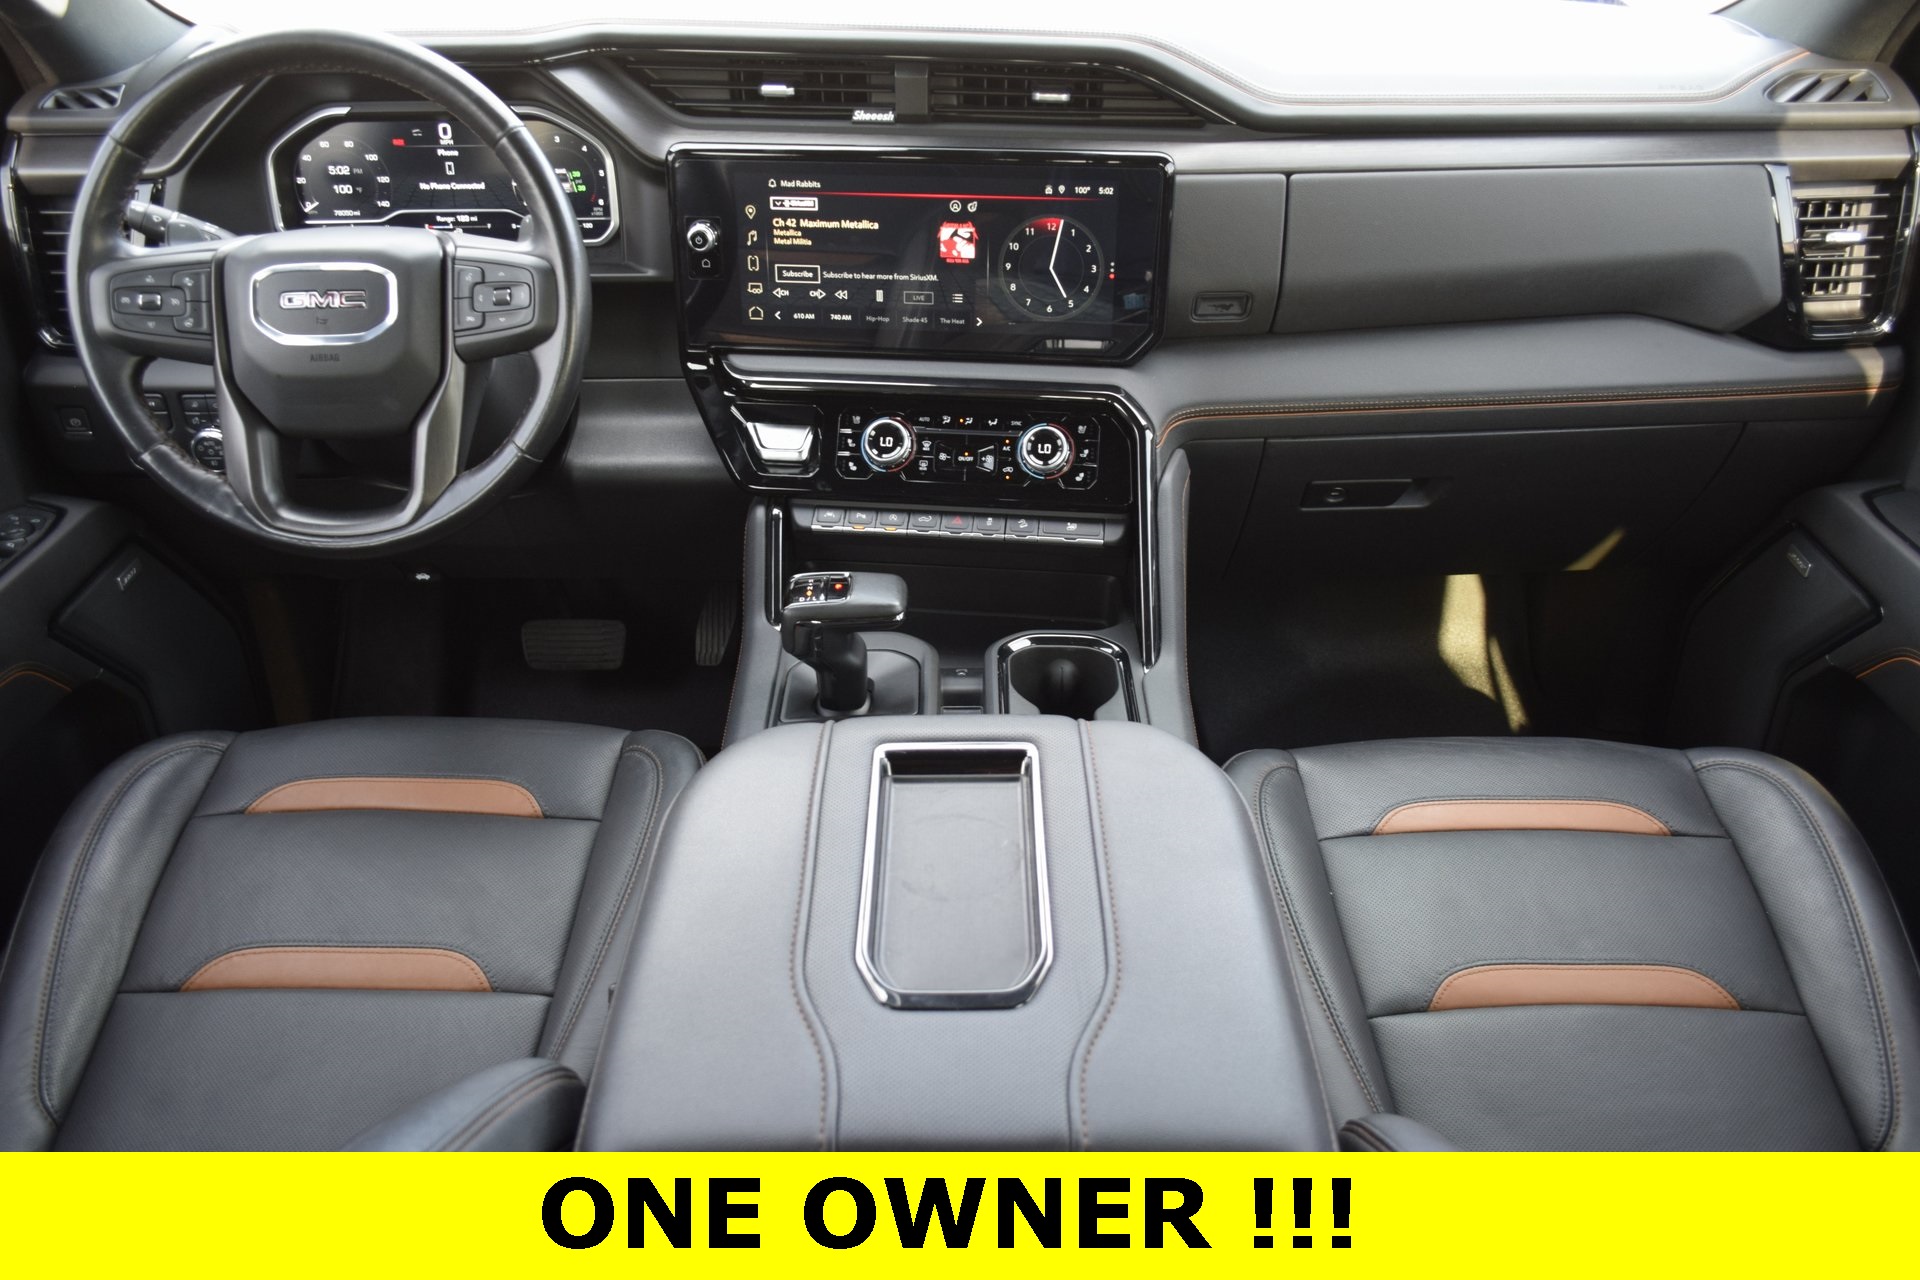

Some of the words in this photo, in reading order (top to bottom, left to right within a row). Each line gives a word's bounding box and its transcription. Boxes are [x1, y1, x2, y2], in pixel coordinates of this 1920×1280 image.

[438, 123, 452, 139] 0
[328, 166, 350, 175] 5:02
[333, 184, 353, 194] 100
[451, 182, 485, 190] Connected
[773, 218, 784, 227] Ch
[786, 219, 796, 227] 42
[800, 219, 840, 228] Maximum
[841, 220, 879, 229] Metallica
[1009, 242, 1019, 250] 10
[782, 270, 813, 278] Subscribe
[910, 273, 939, 281] SiriusXM.
[280, 291, 367, 309] GMC
[310, 354, 340, 362] AIRBAG
[880, 436, 893, 447] LO
[1038, 444, 1052, 454] LO
